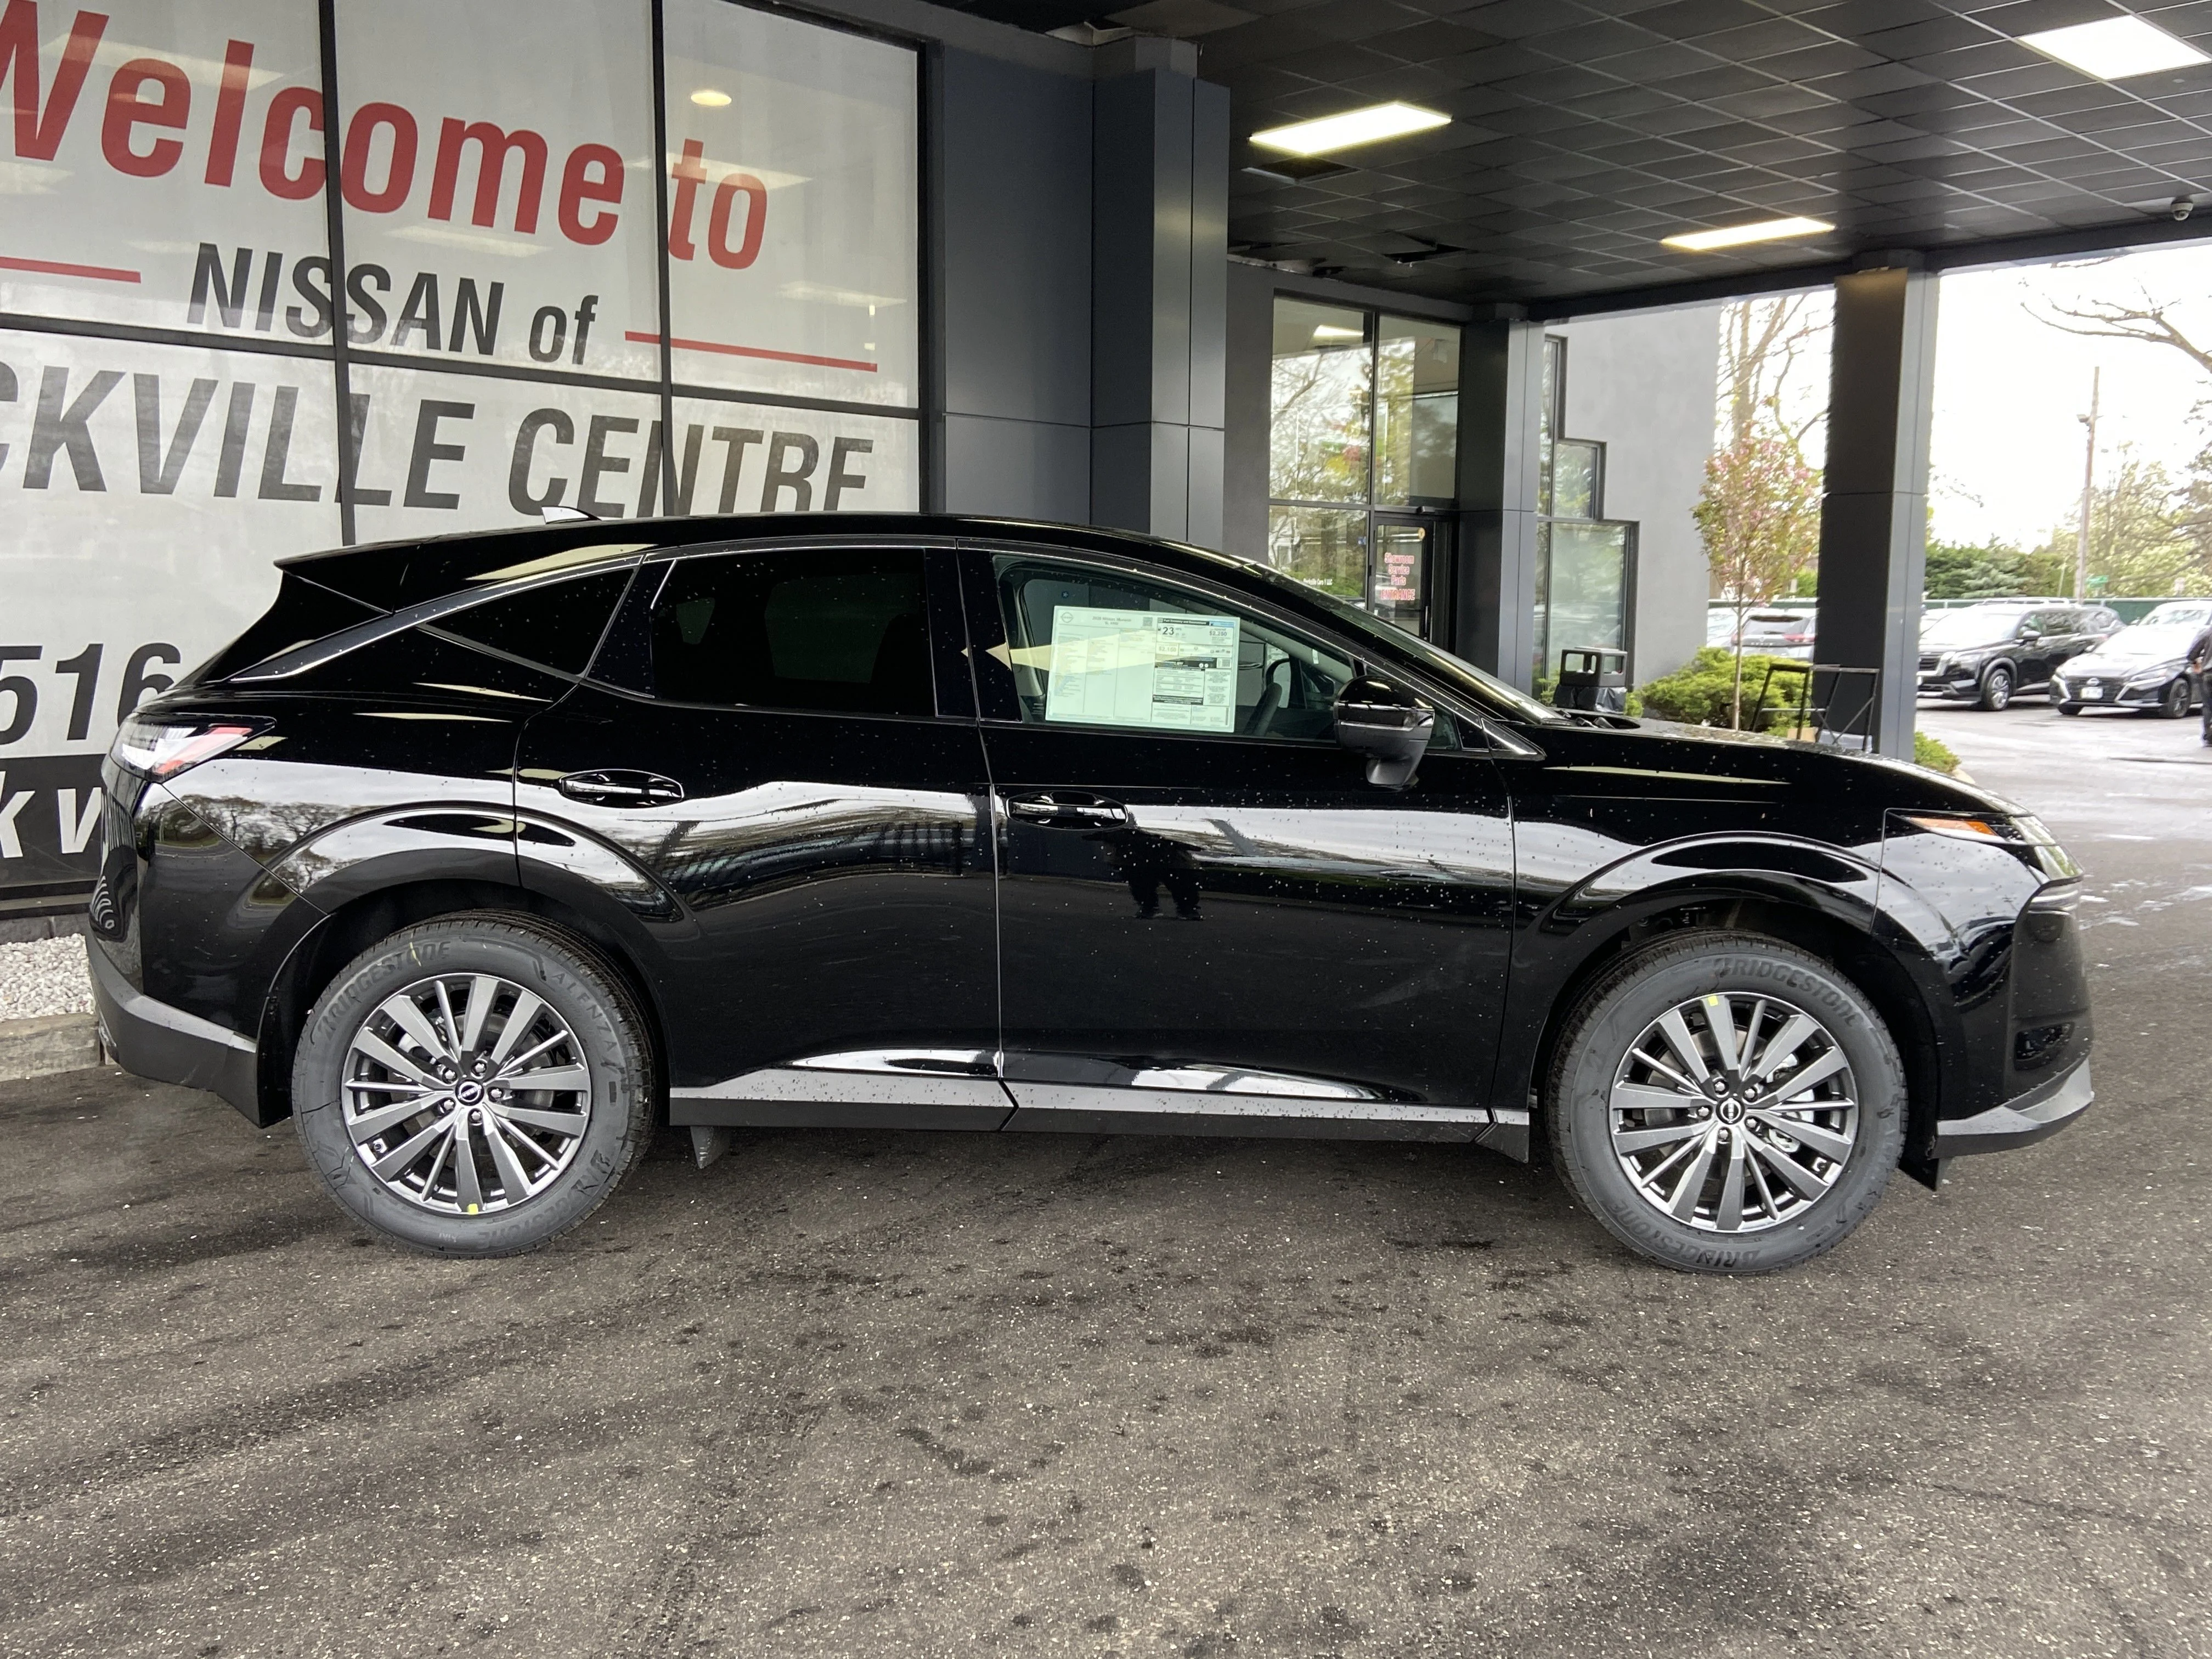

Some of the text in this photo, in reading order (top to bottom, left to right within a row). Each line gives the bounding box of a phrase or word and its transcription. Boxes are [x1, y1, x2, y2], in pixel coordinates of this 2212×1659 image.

[668, 138, 768, 270] to
[187, 242, 599, 365] NISSAN of
[1388, 564, 1410, 575] Service
[1391, 575, 1407, 586] Parts
[1380, 588, 1416, 601] ENTRANCE
[1163, 627, 1174, 635] 23
